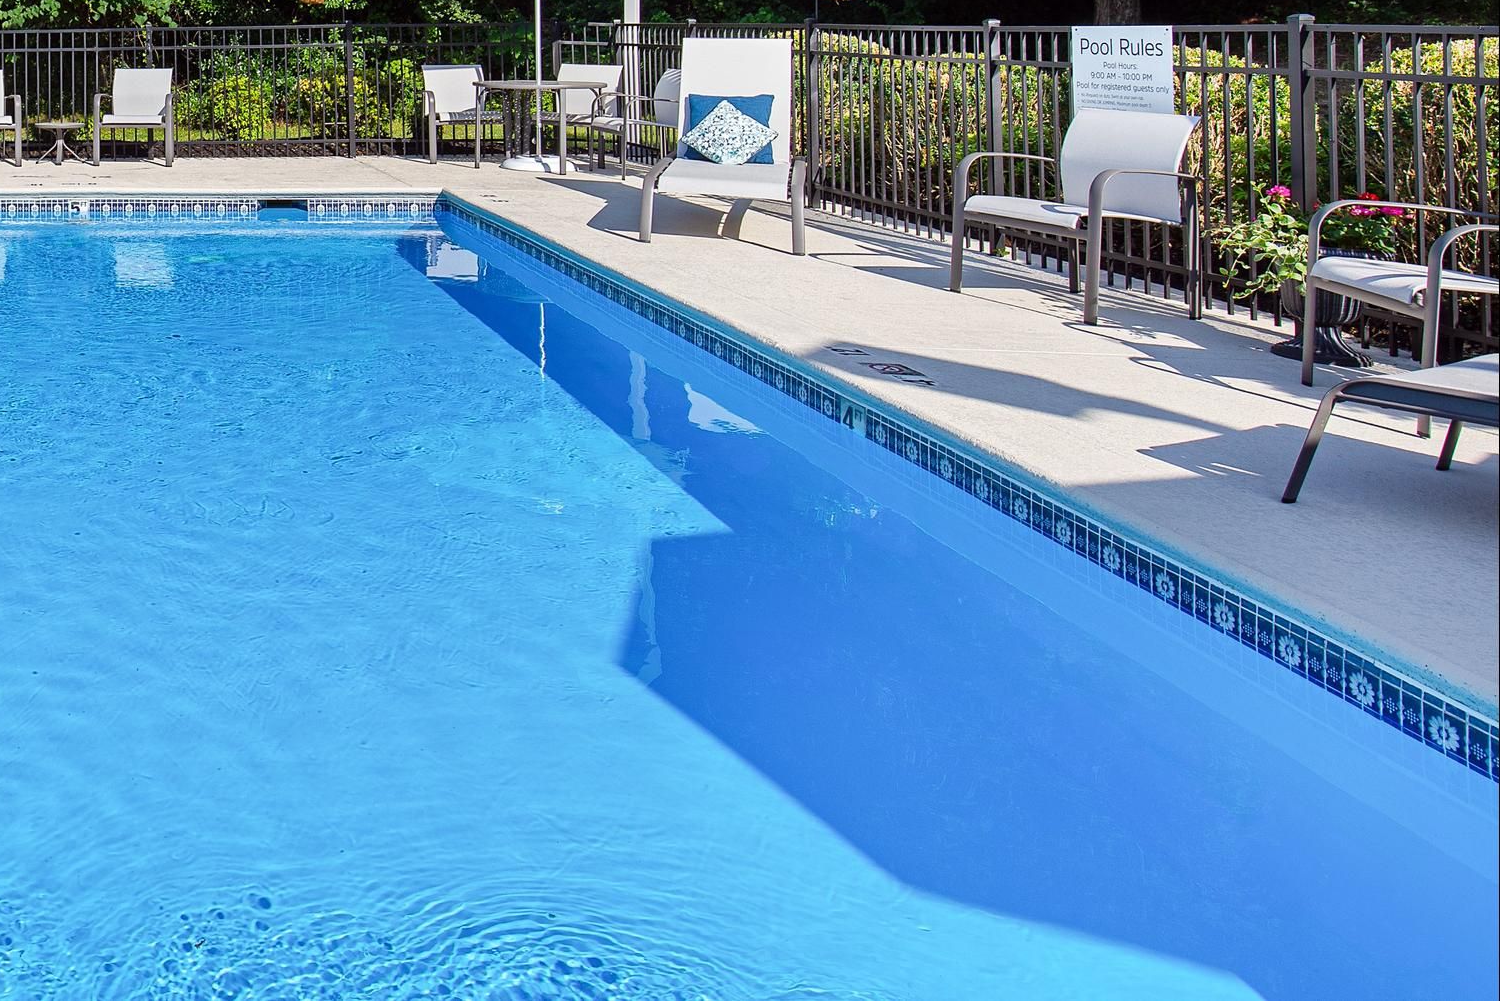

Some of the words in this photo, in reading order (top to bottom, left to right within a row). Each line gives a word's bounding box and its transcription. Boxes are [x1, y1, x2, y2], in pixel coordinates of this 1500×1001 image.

[1080, 38, 1113, 55] Pool
[1119, 38, 1164, 56] Rules
[1103, 61, 1116, 69] Pool
[1122, 73, 1140, 81] 10:00
[1142, 73, 1153, 81] PM
[1076, 81, 1089, 89] Pool
[1101, 82, 1131, 91] registered
[1133, 84, 1154, 93] guests
[1156, 85, 1170, 94] only
[70, 202, 80, 215] 5
[843, 406, 855, 430] 4
[855, 409, 863, 422] FT
